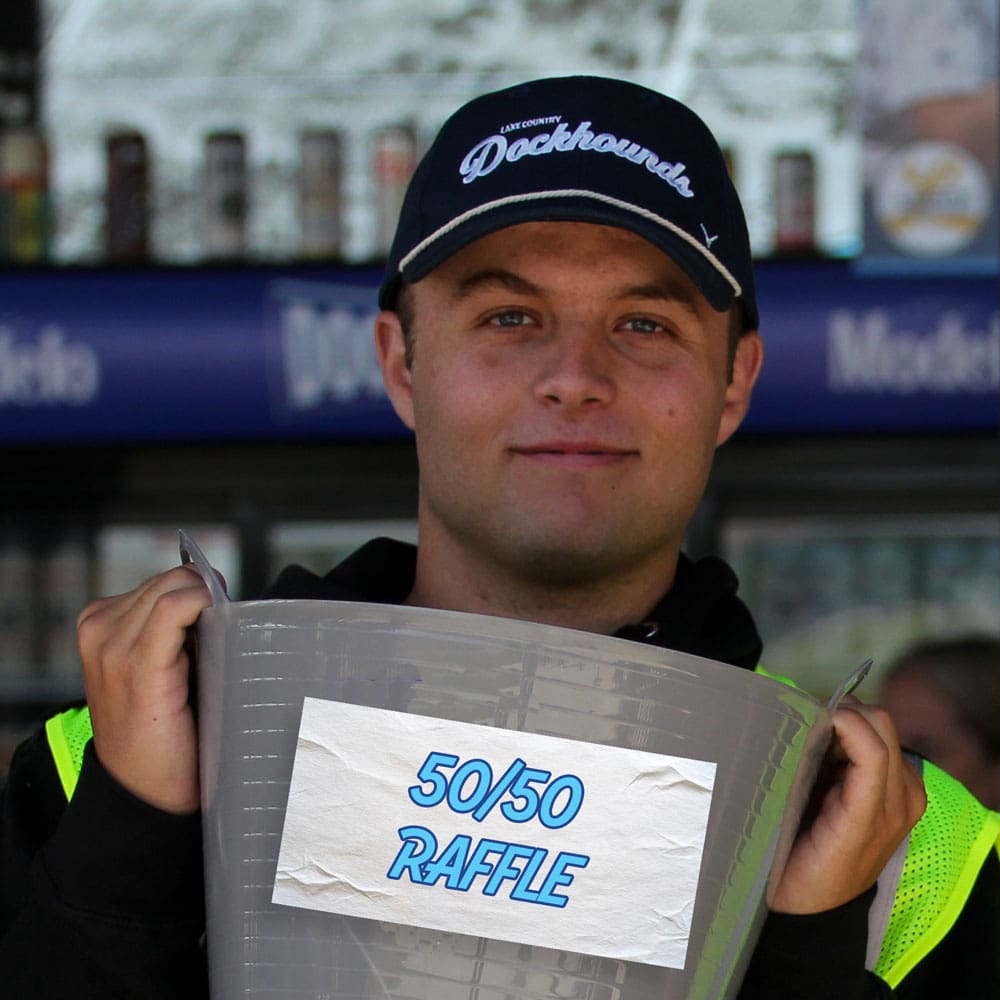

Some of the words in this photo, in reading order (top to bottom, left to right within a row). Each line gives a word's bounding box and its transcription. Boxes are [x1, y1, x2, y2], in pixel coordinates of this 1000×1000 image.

[459, 121, 694, 198] Dockhounds
[500, 121, 521, 134] LAKE
[521, 115, 562, 128] COUNTRY
[408, 751, 585, 829] 50/50
[386, 825, 590, 909] RAFFLE
